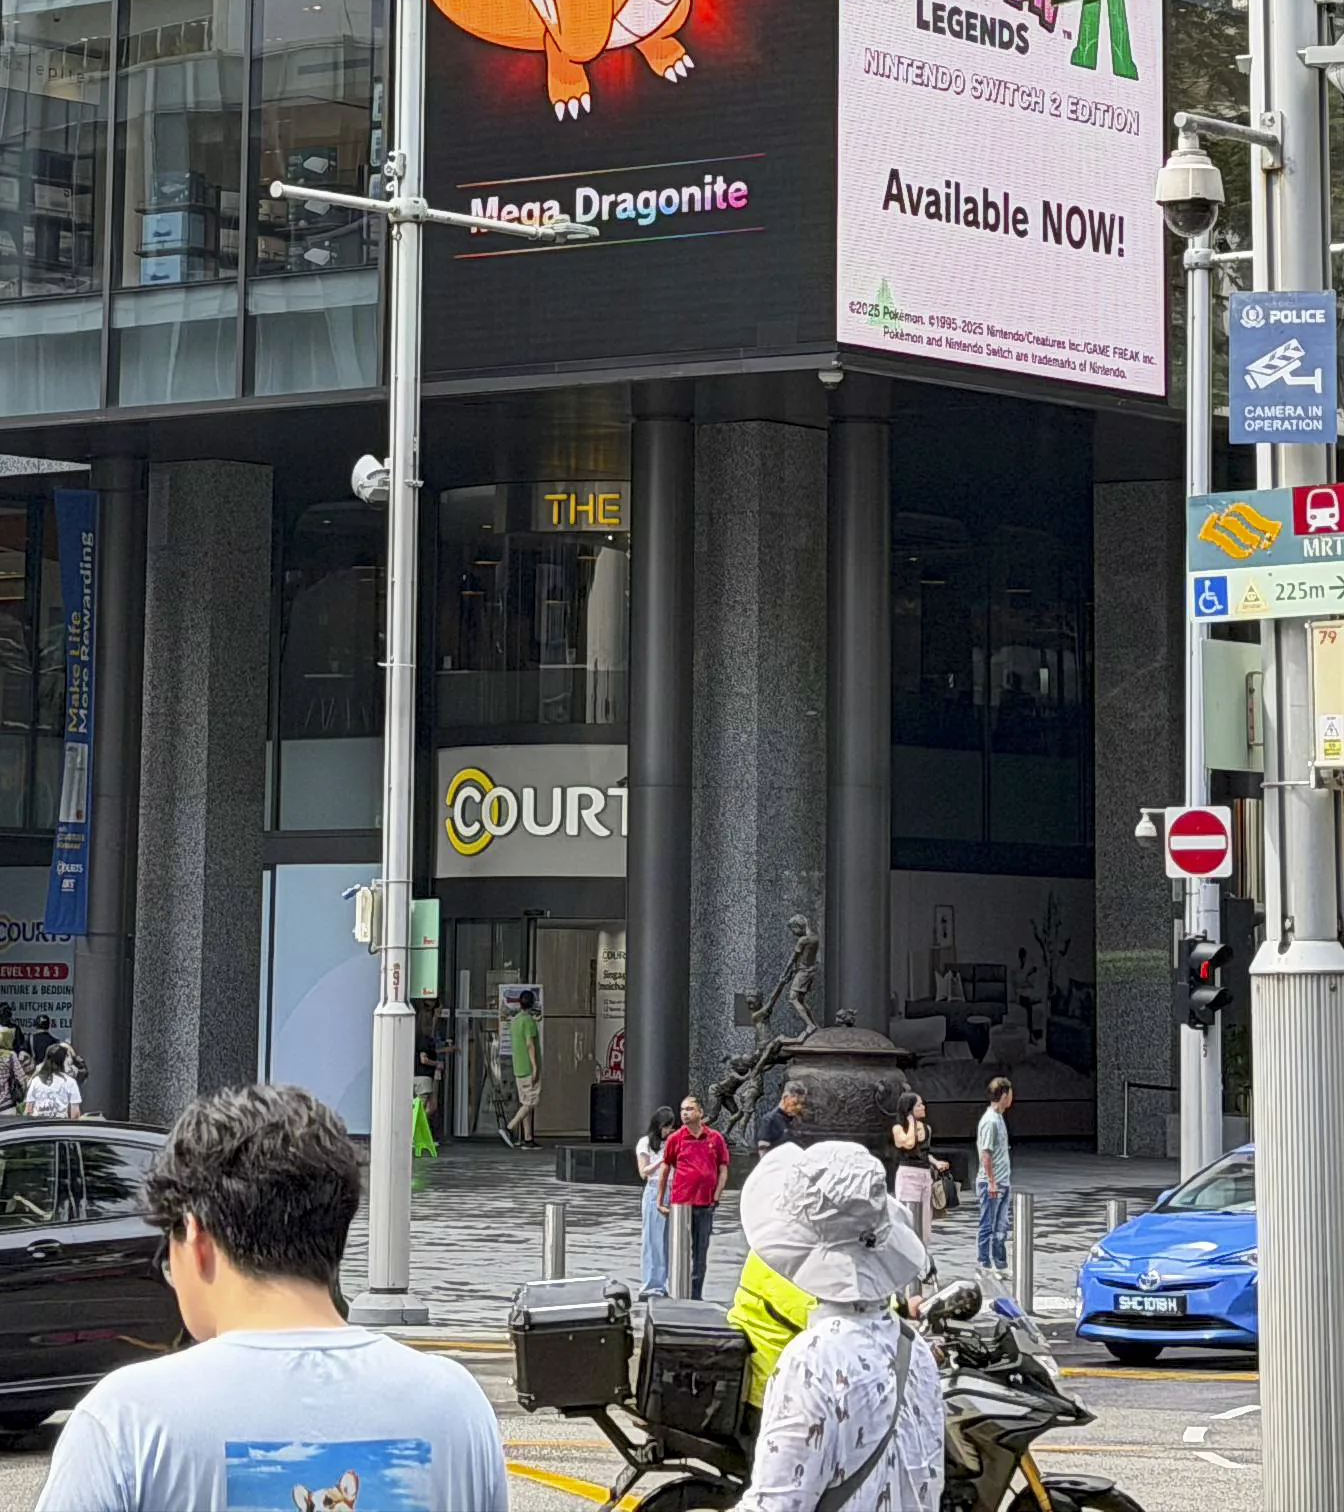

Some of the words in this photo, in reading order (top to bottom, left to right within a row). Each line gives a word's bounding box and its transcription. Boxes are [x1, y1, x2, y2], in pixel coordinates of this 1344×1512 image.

[864, 47, 966, 96] NINTENDO
[970, 74, 1044, 114] SWITCH
[1049, 91, 1062, 117] 2
[1066, 96, 1140, 136] EDITION
[574, 174, 750, 226] Dragonite
[882, 168, 1030, 239] Available
[1042, 199, 1125, 258] NOW!
[1269, 309, 1326, 325] POLICE
[883, 325, 924, 345] Pokémon
[926, 336, 943, 347] and
[945, 337, 983, 355] Nintendo
[985, 343, 1014, 360] Switch
[1015, 351, 1029, 363] are
[1031, 352, 1077, 371] trademarks
[1113, 346, 1141, 363] FREAK
[1244, 405, 1305, 418] CAMERA
[1308, 405, 1323, 417] IN
[1244, 419, 1323, 431] OPERATION
[544, 493, 621, 525] THE
[1303, 536, 1344, 558] MRT
[80, 532, 94, 661] Rewarding
[1275, 581, 1325, 601] 225m
[68, 611, 81, 656] Life
[1319, 630, 1337, 645] 79
[67, 664, 80, 733] Make
[79, 668, 89, 733] More
[453, 786, 628, 837] COURT
[19, 1001, 54, 1011] KITCHEN
